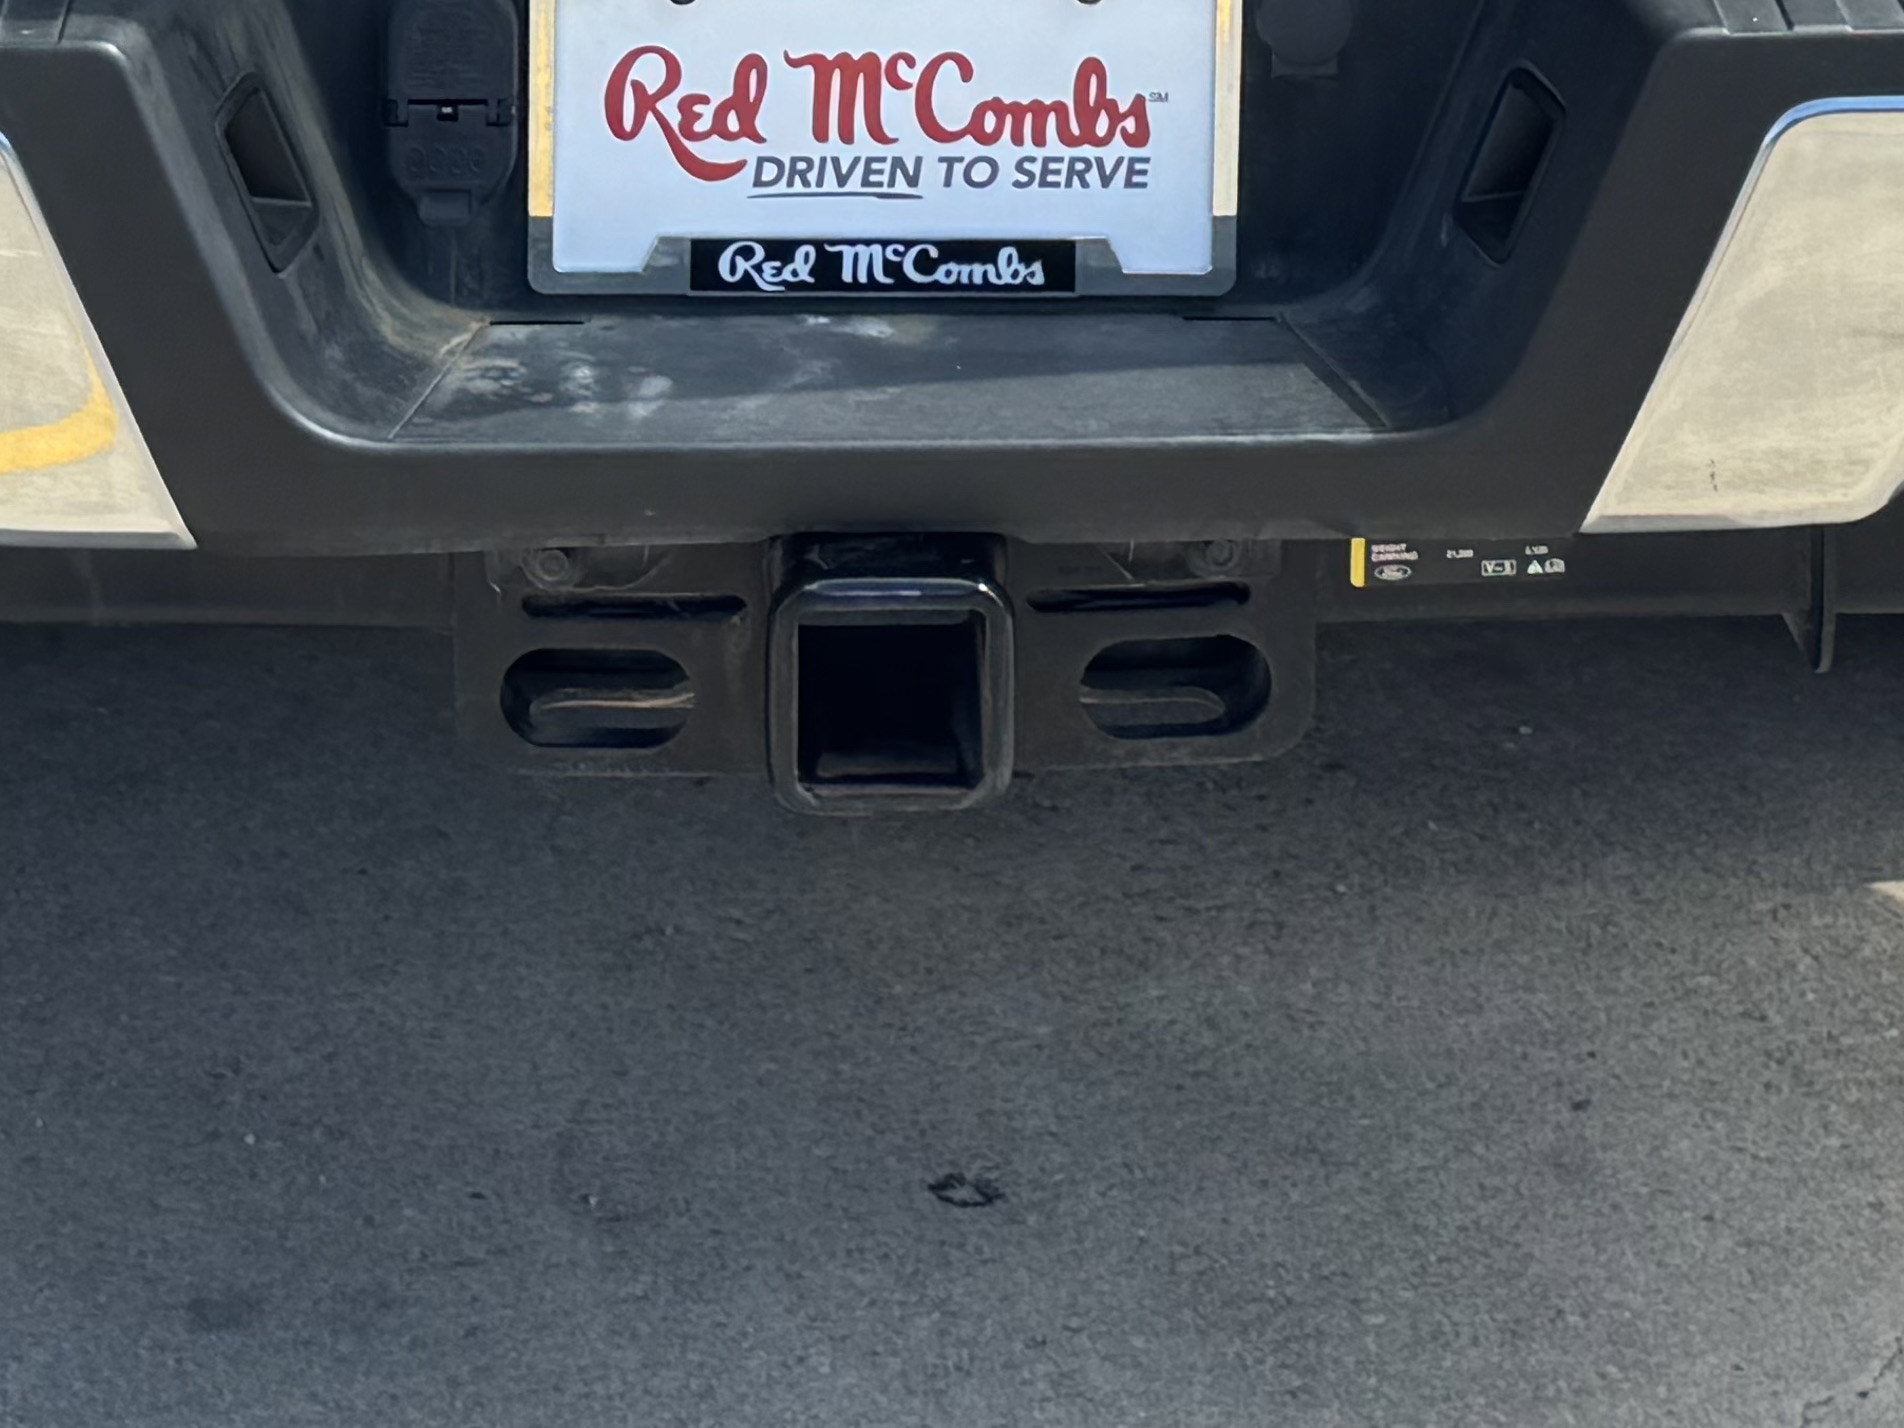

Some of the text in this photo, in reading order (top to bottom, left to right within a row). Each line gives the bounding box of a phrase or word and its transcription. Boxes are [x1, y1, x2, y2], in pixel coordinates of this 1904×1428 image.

[604, 45, 768, 182] Red
[783, 50, 1151, 148] McCombs
[752, 155, 1152, 190] DRIVEN TO SERVE
[718, 240, 1045, 292] Red McCombs
